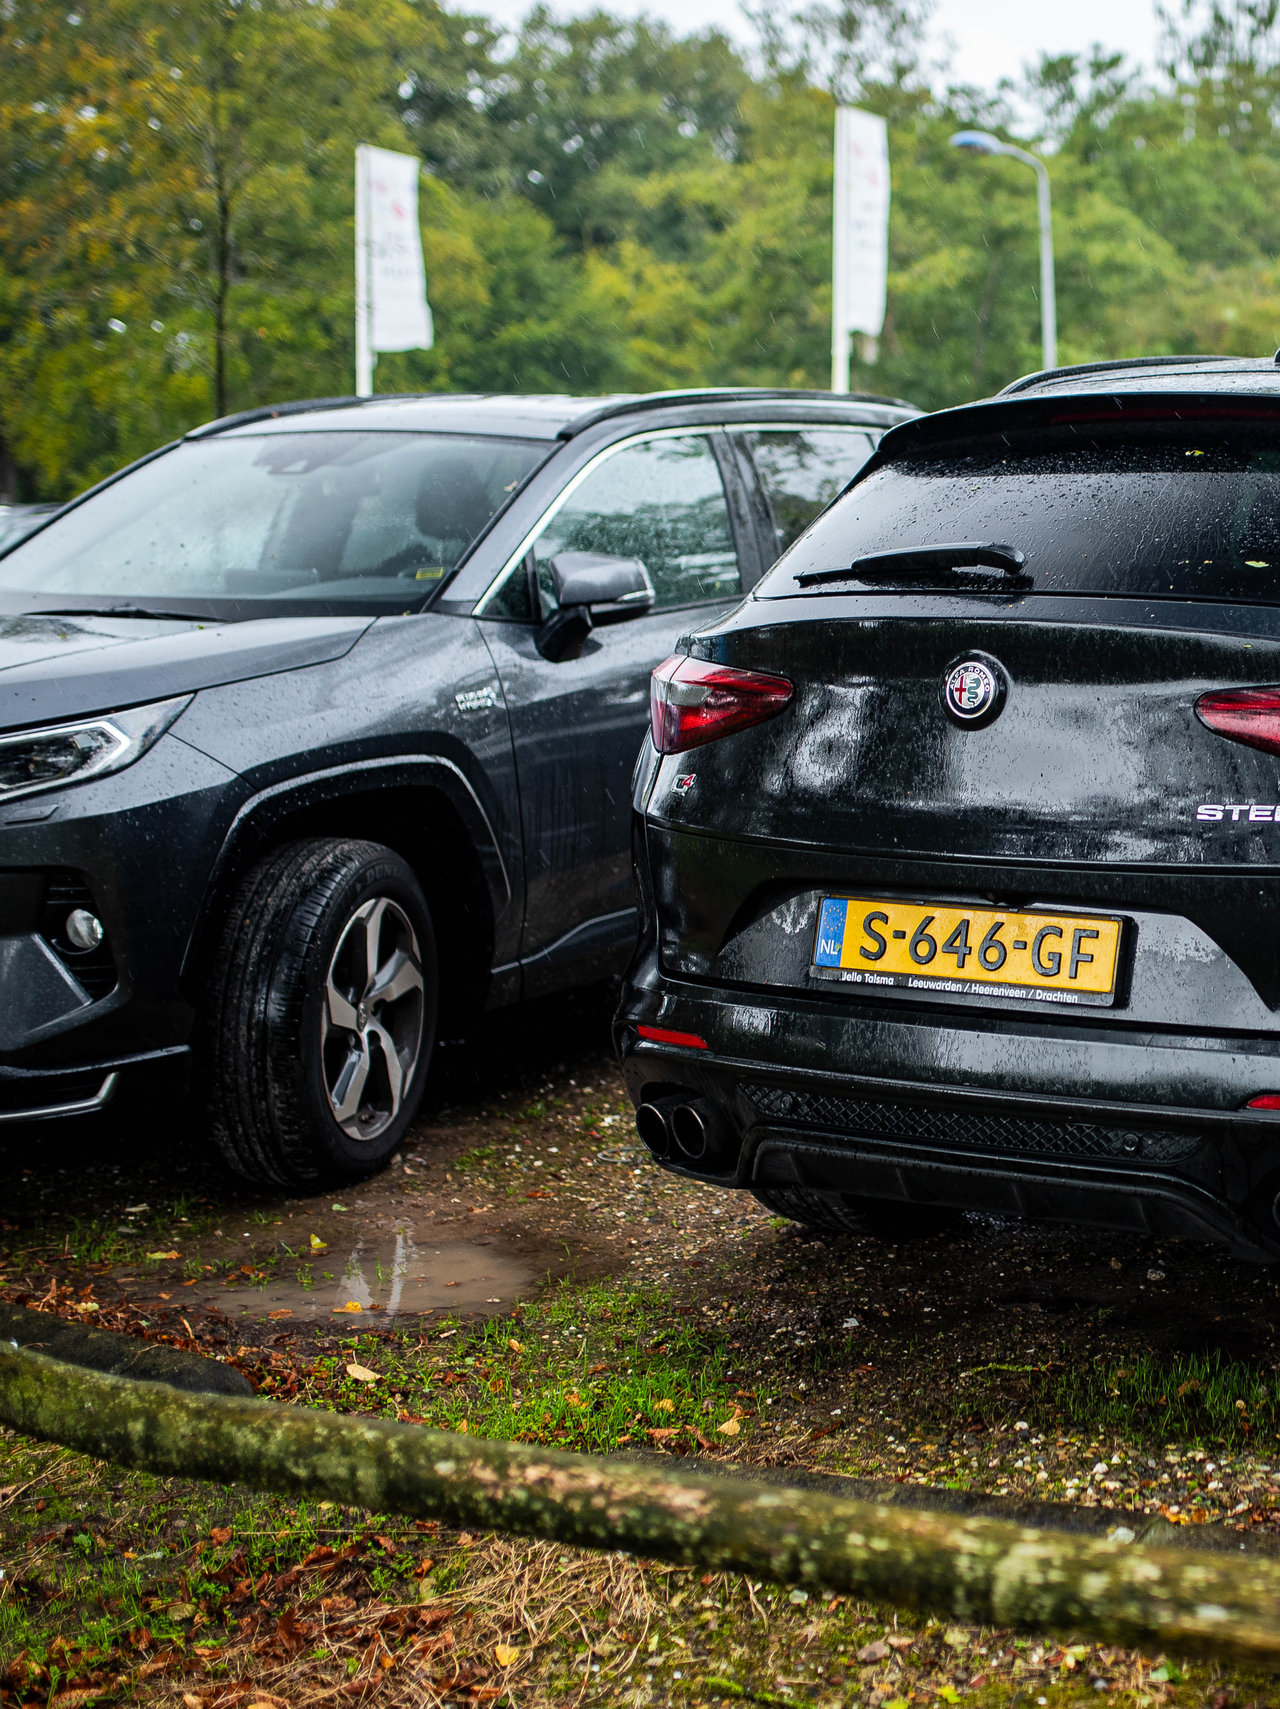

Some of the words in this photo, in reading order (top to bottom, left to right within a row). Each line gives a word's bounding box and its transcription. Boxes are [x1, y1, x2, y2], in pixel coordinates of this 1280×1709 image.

[950, 670, 964, 690] ALFA
[968, 667, 990, 692] ROMEO
[671, 774, 696, 796] Q4
[820, 938, 838, 955] NL
[859, 910, 1100, 979] S-646-GF
[841, 971, 862, 982] Jelle
[864, 973, 894, 985] Talsma
[908, 977, 962, 992] Leeuwarden
[964, 983, 970, 992] /
[971, 983, 1026, 998] Heerenveen
[1028, 989, 1034, 999] /
[1036, 989, 1078, 1003] Drachten
